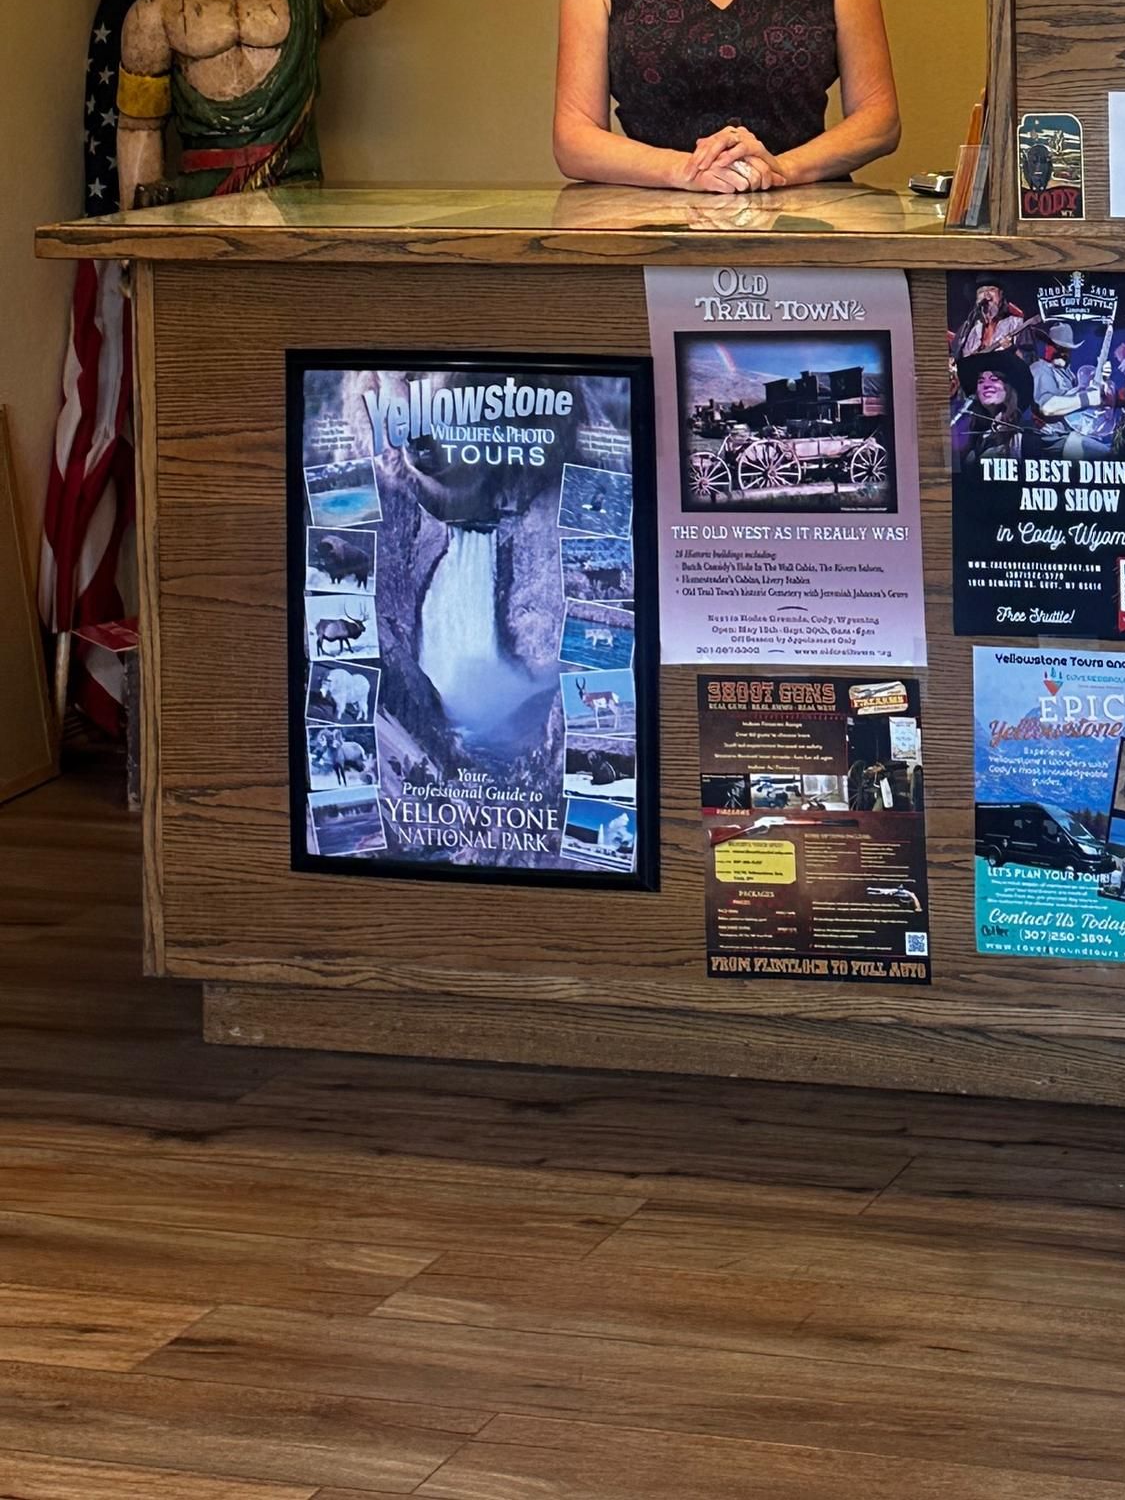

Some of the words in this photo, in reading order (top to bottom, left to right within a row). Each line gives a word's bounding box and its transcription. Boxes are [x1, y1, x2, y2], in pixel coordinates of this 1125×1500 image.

[1024, 190, 1078, 214] CODY
[695, 297, 772, 322] TRAIL
[362, 376, 573, 456] Yellowstone
[431, 424, 491, 442] WILDLIFE
[506, 426, 555, 443] PHOTO
[442, 444, 545, 466] TOURS
[980, 458, 1018, 481] THE
[1025, 459, 1072, 483] BEST
[1019, 487, 1058, 511] AND
[1064, 489, 1120, 512] SHOW
[671, 525, 698, 539] THE
[702, 526, 727, 539] OLD
[732, 526, 771, 539] WEST
[774, 527, 792, 540] AS
[797, 527, 810, 540] IT
[814, 527, 867, 540] REALLY
[872, 527, 909, 541] WAS!
[996, 525, 1014, 541] in
[682, 588, 695, 596] Old
[996, 606, 1026, 623] Free
[1029, 608, 1075, 624] Shuttle!
[995, 653, 1068, 667] Yellowstone
[1070, 656, 1104, 669] Tours
[779, 683, 836, 704] GUNS
[1038, 693, 1125, 723] EPIC
[989, 715, 1123, 748] Yellowstone
[457, 768, 488, 782] Your
[402, 782, 482, 800] Professional
[486, 787, 526, 801] Guide
[530, 789, 543, 802] to
[385, 798, 560, 830] YELLOWSTONE
[399, 827, 497, 849] NATIONAL
[502, 832, 549, 852] PARK
[988, 866, 1012, 878] LET'S
[1014, 868, 1040, 879] PLAN
[1045, 869, 1074, 881] YOUR
[1076, 871, 1110, 883] TOUR!
[989, 908, 1053, 925] Contact
[1056, 912, 1075, 928] Us
[711, 957, 751, 972] FROM
[754, 958, 829, 975] FLINTLOCK
[832, 961, 848, 974] TO
[851, 962, 887, 976] FULL
[889, 962, 926, 978] AUTO
